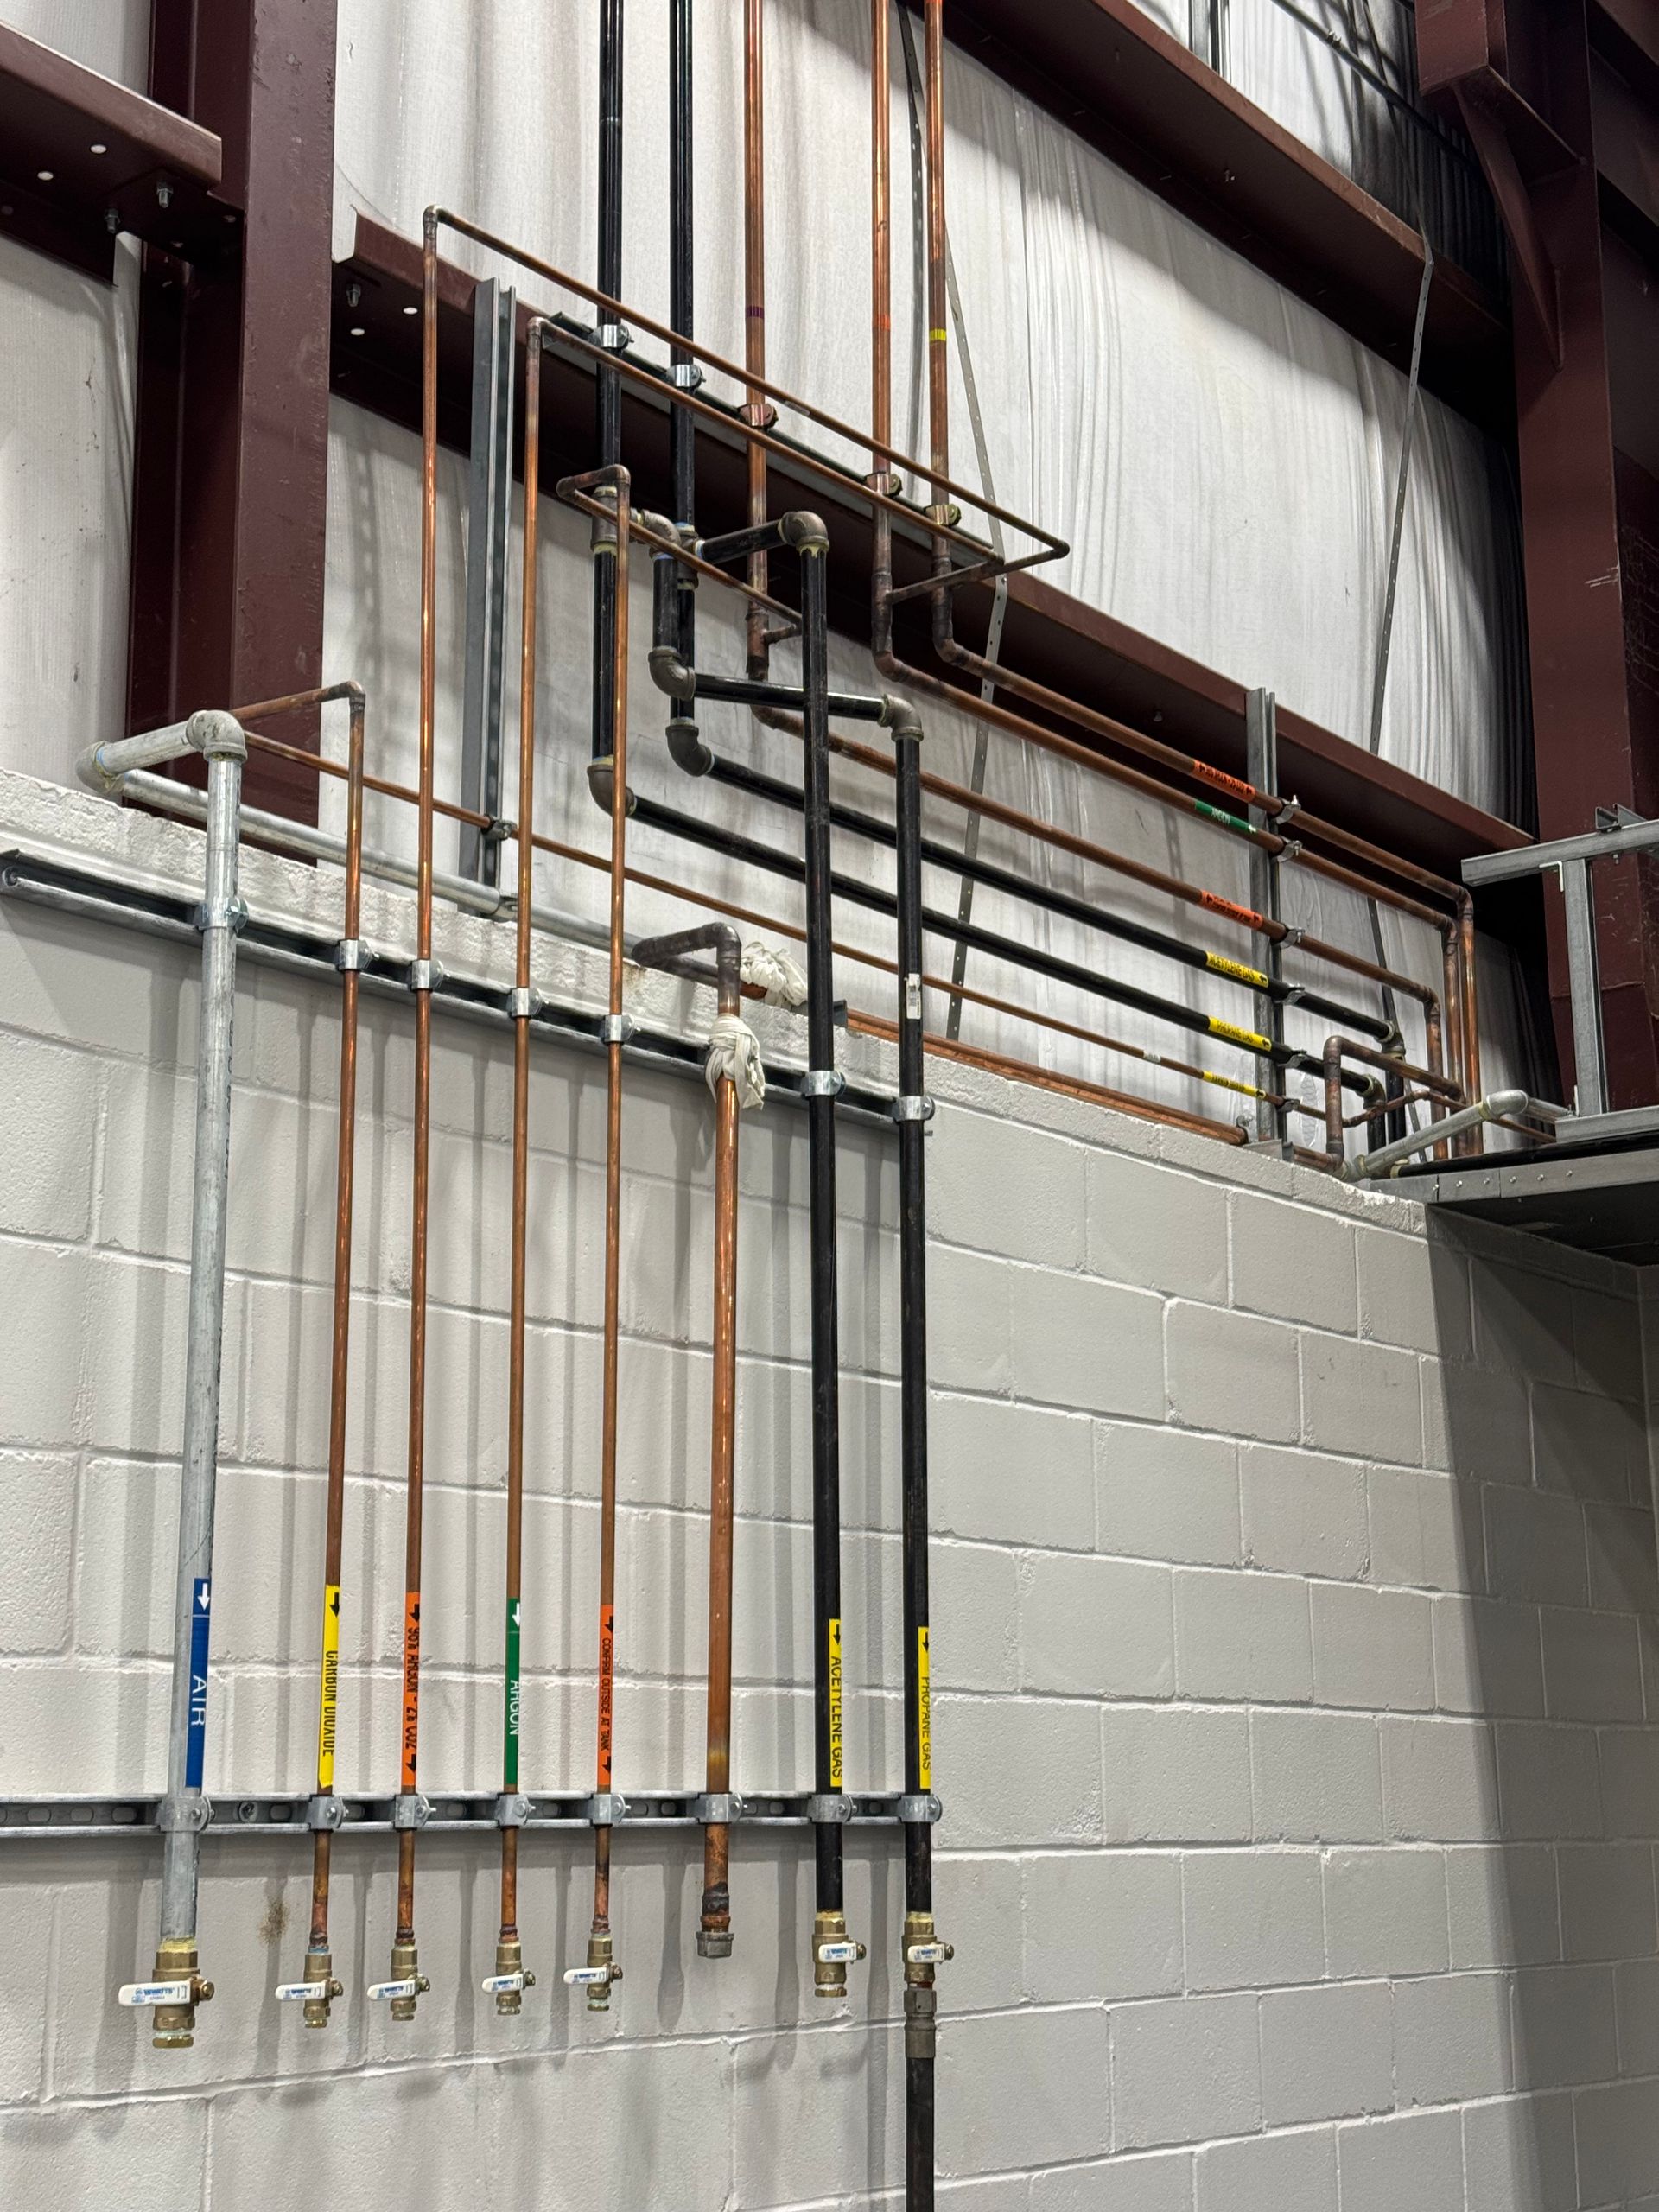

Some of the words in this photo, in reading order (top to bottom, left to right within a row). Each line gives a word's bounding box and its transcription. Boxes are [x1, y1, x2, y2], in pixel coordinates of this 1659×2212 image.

[601, 1637, 612, 1675] CONFIRM
[324, 1650, 339, 1702] CARBON
[190, 1674, 207, 1727] AIR
[509, 1679, 520, 1735] ARGON
[601, 1678, 611, 1714] OUTSIDE
[831, 1656, 842, 1743] ACETYLENE
[601, 1716, 610, 1729] AT
[601, 1729, 610, 1752] TANK
[832, 1746, 842, 1778] GAS
[922, 1741, 931, 1770] GAS
